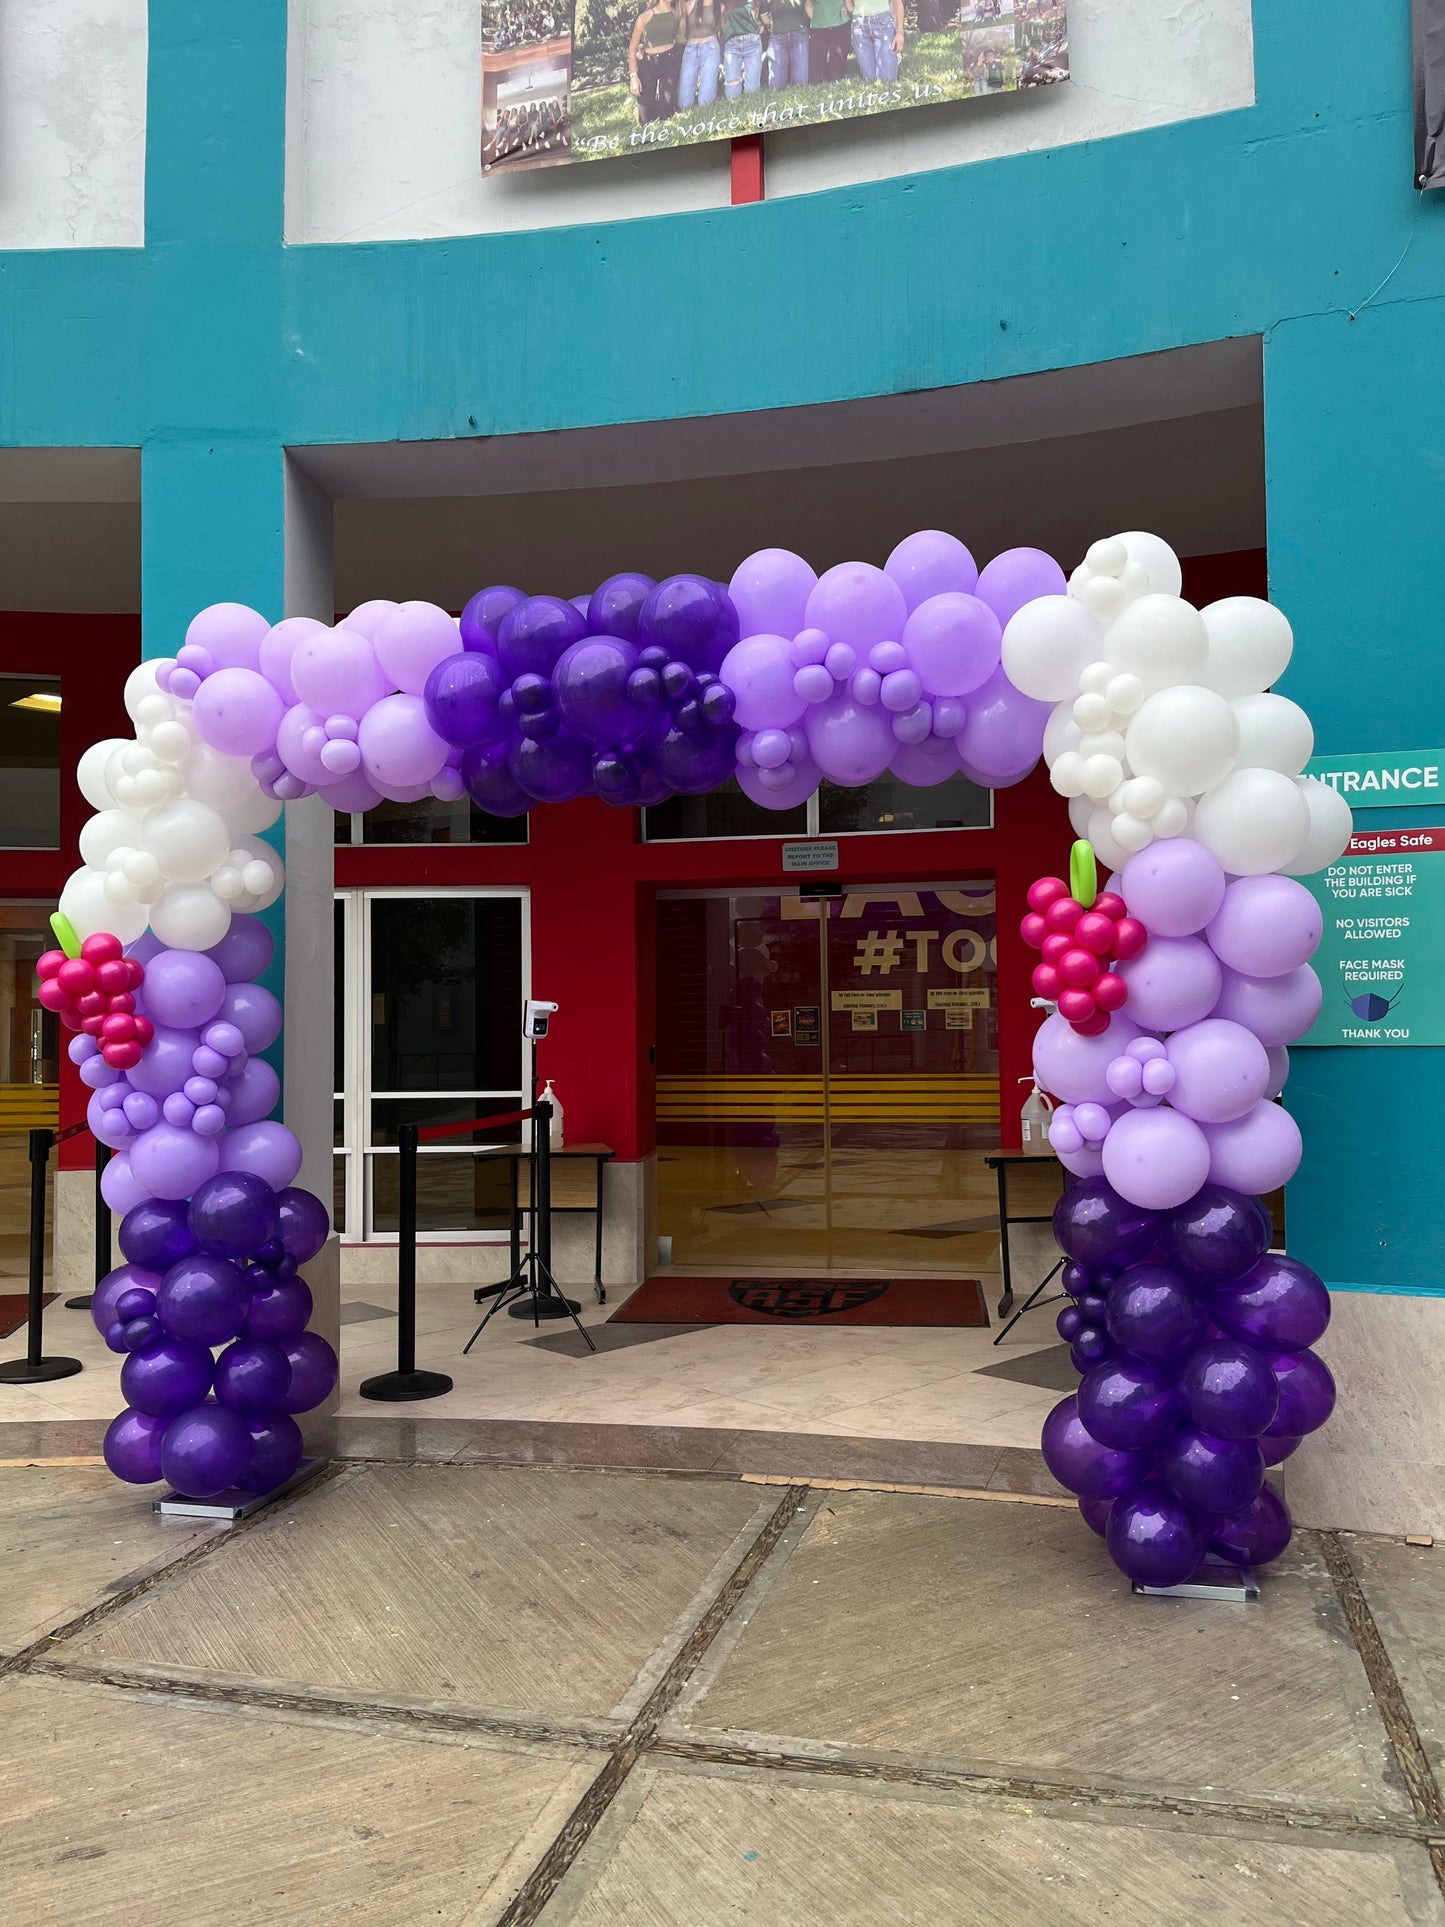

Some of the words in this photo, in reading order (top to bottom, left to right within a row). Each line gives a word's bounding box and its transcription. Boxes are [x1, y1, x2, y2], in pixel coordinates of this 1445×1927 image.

[630, 122, 670, 146] the
[678, 116, 740, 138] voice
[750, 101, 809, 127] that
[818, 89, 902, 115] unites
[1350, 836, 1397, 851] Eagles
[1399, 833, 1433, 847] Safe
[1327, 866, 1346, 876] DO
[1349, 866, 1373, 875] NOT
[1376, 864, 1413, 874] ENTER
[1324, 878, 1346, 888] THE
[1348, 875, 1404, 887] BUILDING
[1406, 874, 1417, 885] IF
[1332, 889, 1356, 898] YOU
[1359, 888, 1382, 897] ARE
[1385, 886, 1413, 897] SICK
[1336, 918, 1354, 929] NO
[1356, 917, 1410, 928] VISITORS
[1344, 929, 1401, 939] ALLOWED
[853, 928, 997, 974] #TO
[1339, 960, 1369, 970] FACE
[1371, 959, 1405, 969] MASK
[1344, 971, 1403, 981] REQUIRED
[1341, 1029, 1381, 1038] THANK
[1384, 1028, 1410, 1038] YOU
[742, 1289, 869, 1308] ASF
